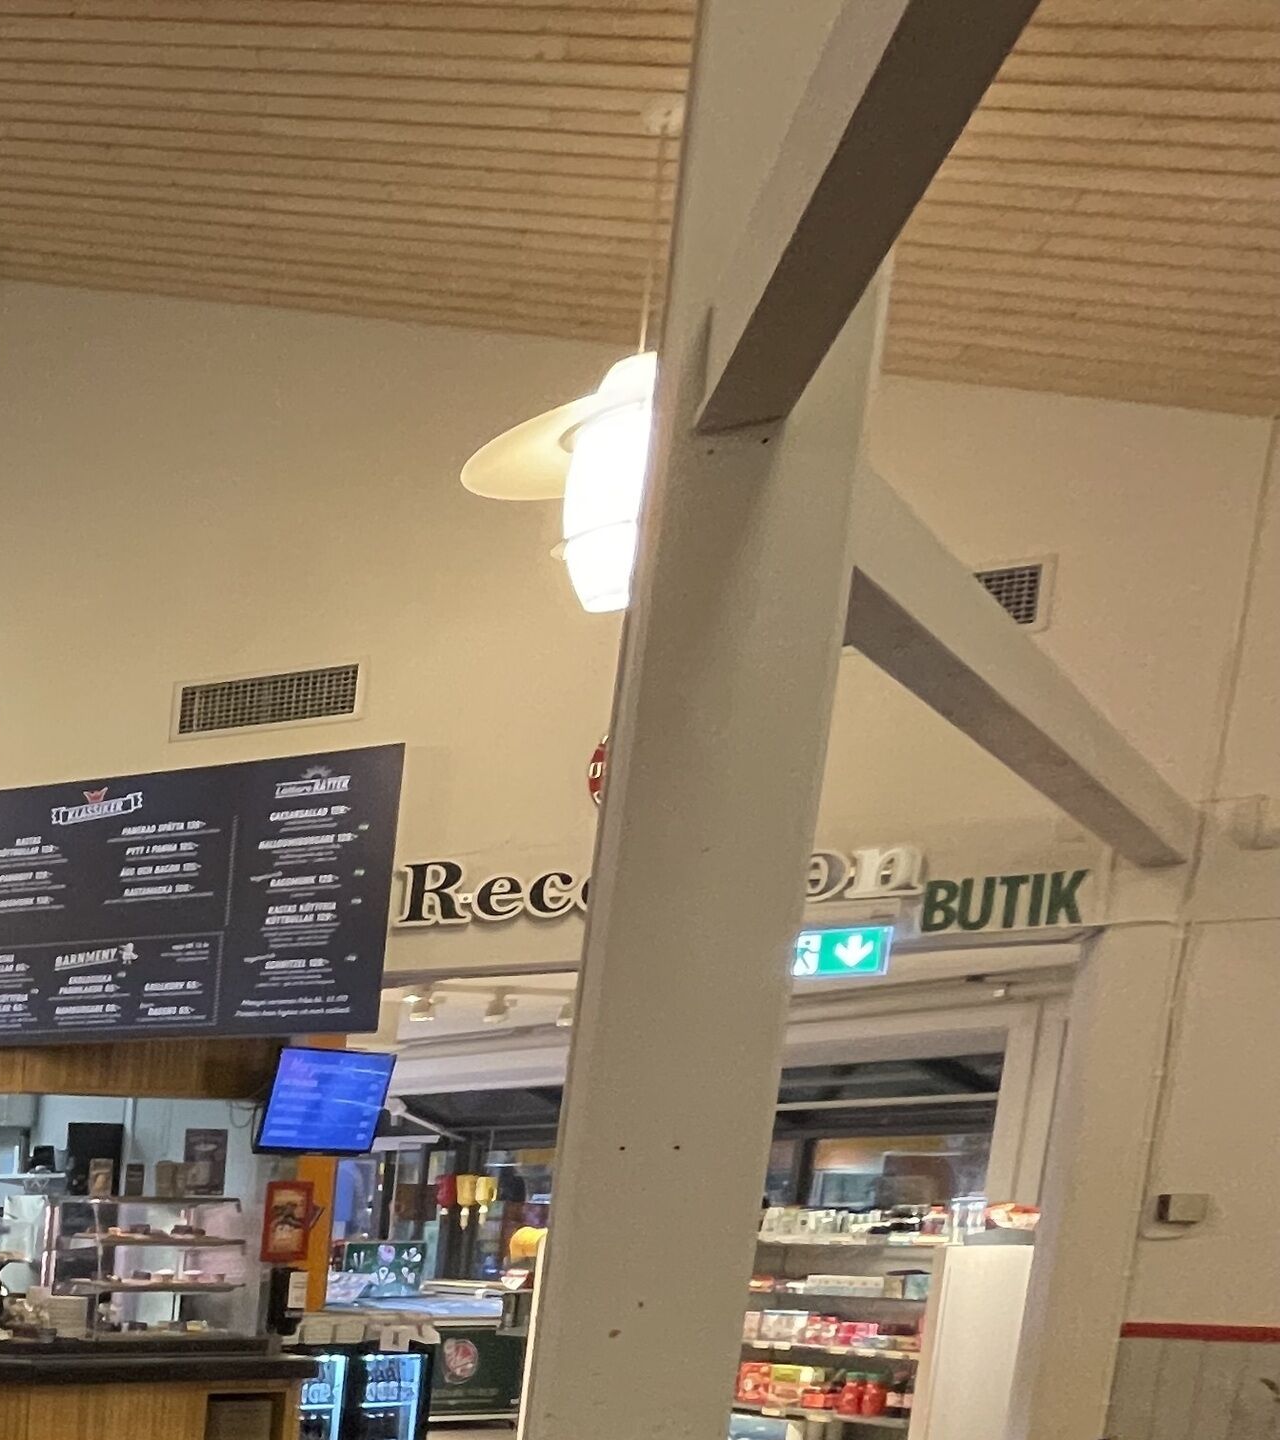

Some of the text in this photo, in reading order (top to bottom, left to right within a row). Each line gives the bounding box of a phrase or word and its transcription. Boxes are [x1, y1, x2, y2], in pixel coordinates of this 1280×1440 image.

[67, 801, 124, 822] KLASSIKER
[394, 846, 926, 928] Recon
[921, 869, 1090, 932] BUTIK
[54, 948, 118, 968] BARNMENY
